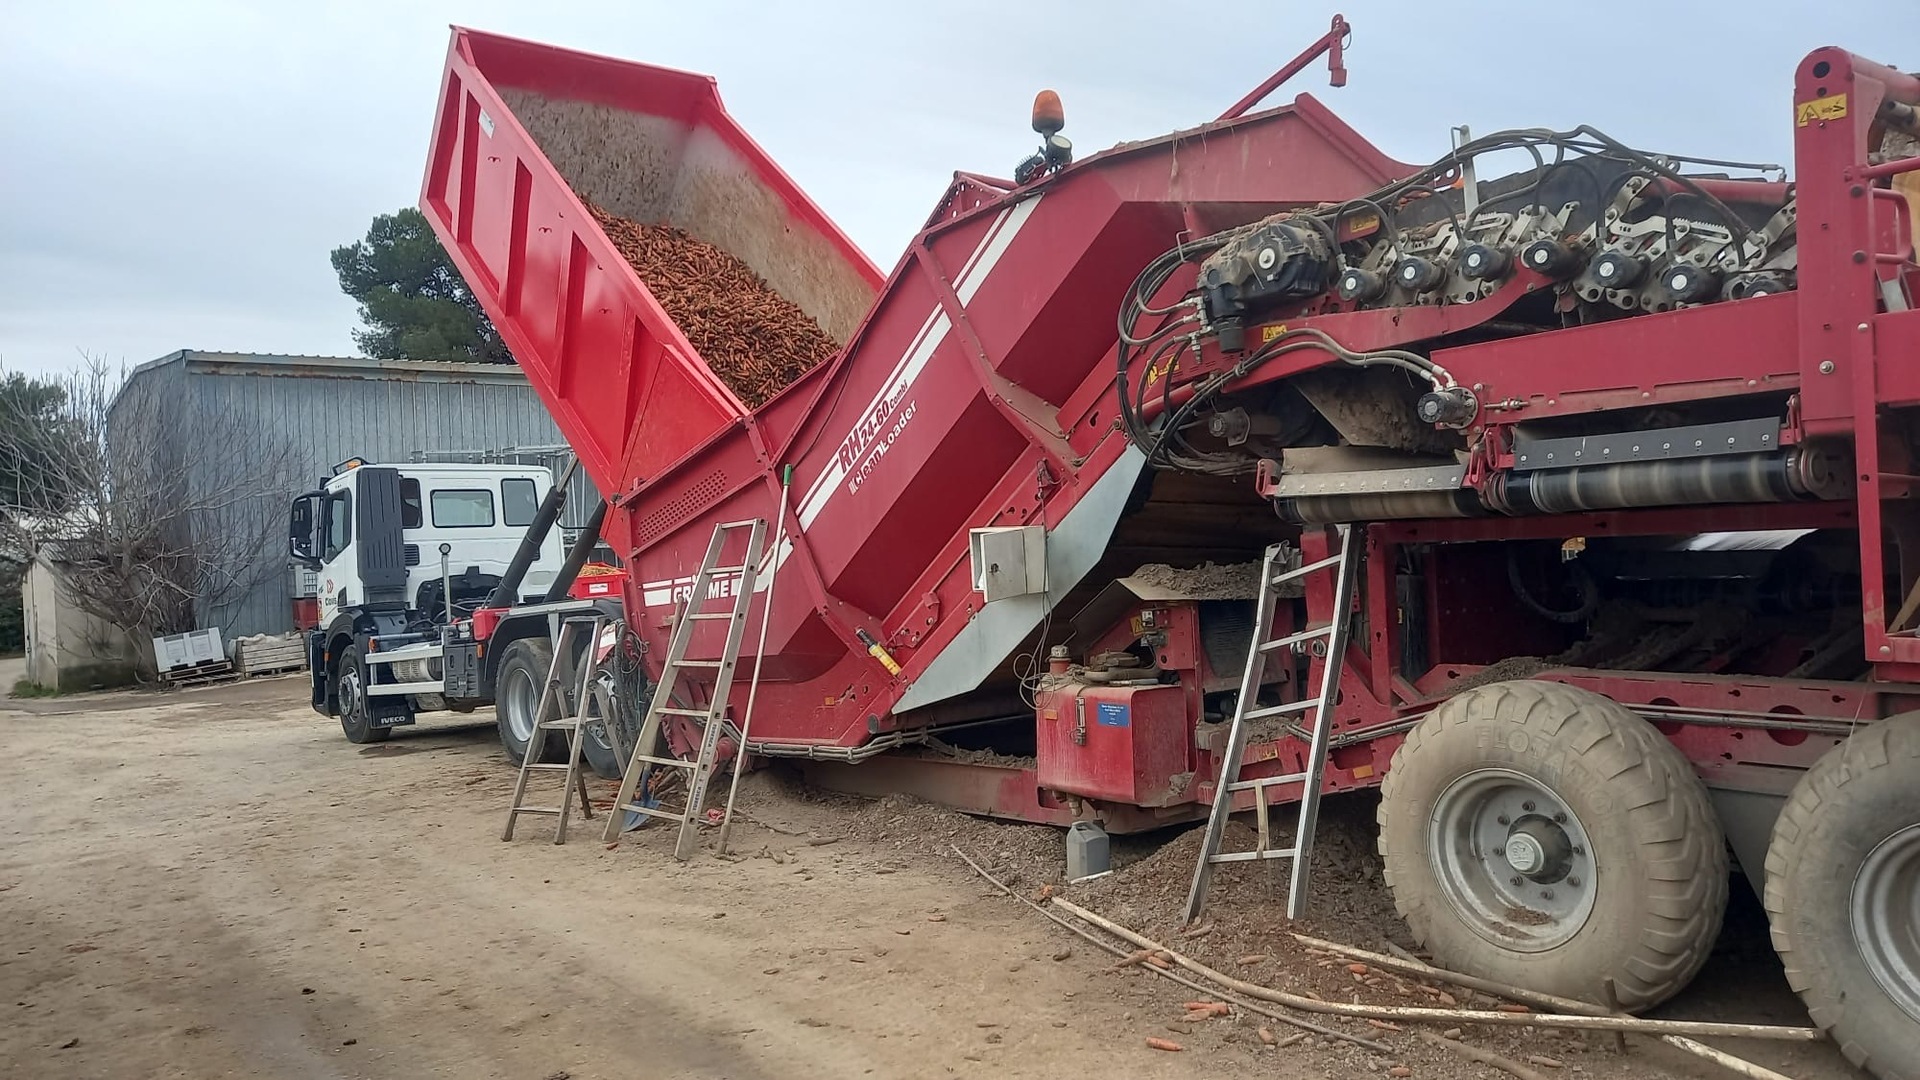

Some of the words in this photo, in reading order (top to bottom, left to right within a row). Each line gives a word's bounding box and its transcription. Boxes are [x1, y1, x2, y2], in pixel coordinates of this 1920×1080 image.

[889, 378, 909, 410] combi
[673, 579, 730, 604] GRME
[380, 715, 406, 724] IVECO
